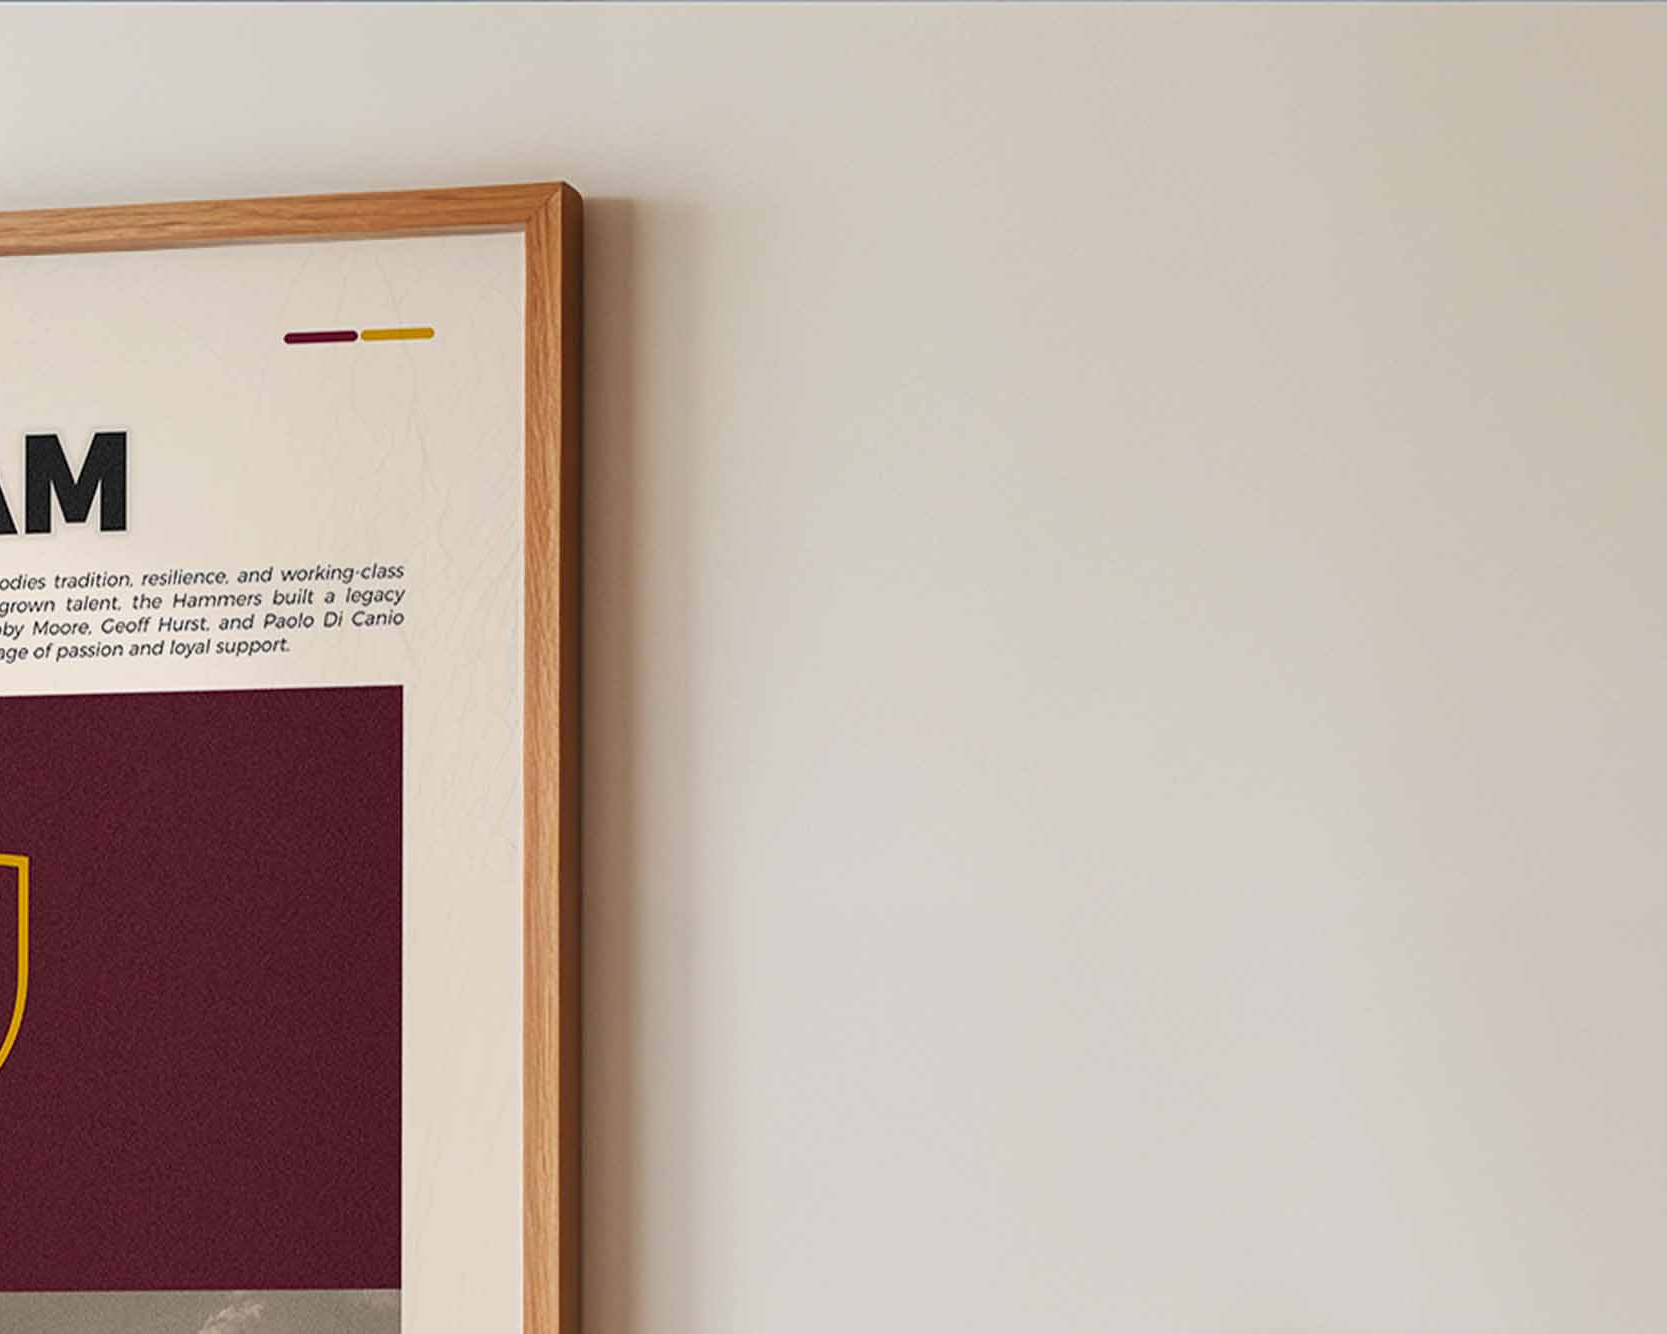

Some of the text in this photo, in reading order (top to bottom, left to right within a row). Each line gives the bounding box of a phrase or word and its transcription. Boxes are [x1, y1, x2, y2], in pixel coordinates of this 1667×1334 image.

[236, 565, 275, 585] and
[280, 562, 405, 585] working-class
[131, 592, 164, 611] the
[172, 592, 263, 609] Hammers
[272, 587, 315, 607] built
[323, 590, 336, 605] a
[345, 586, 406, 608] legacy
[100, 615, 153, 635] Geoff
[217, 612, 256, 632] and
[262, 611, 315, 630] Paolo
[322, 609, 344, 629] Di
[350, 608, 406, 628] Canio
[32, 641, 54, 660] of
[55, 640, 124, 663] passion
[127, 639, 166, 657] and
[169, 637, 212, 660] loyal
[215, 637, 291, 656] support.
